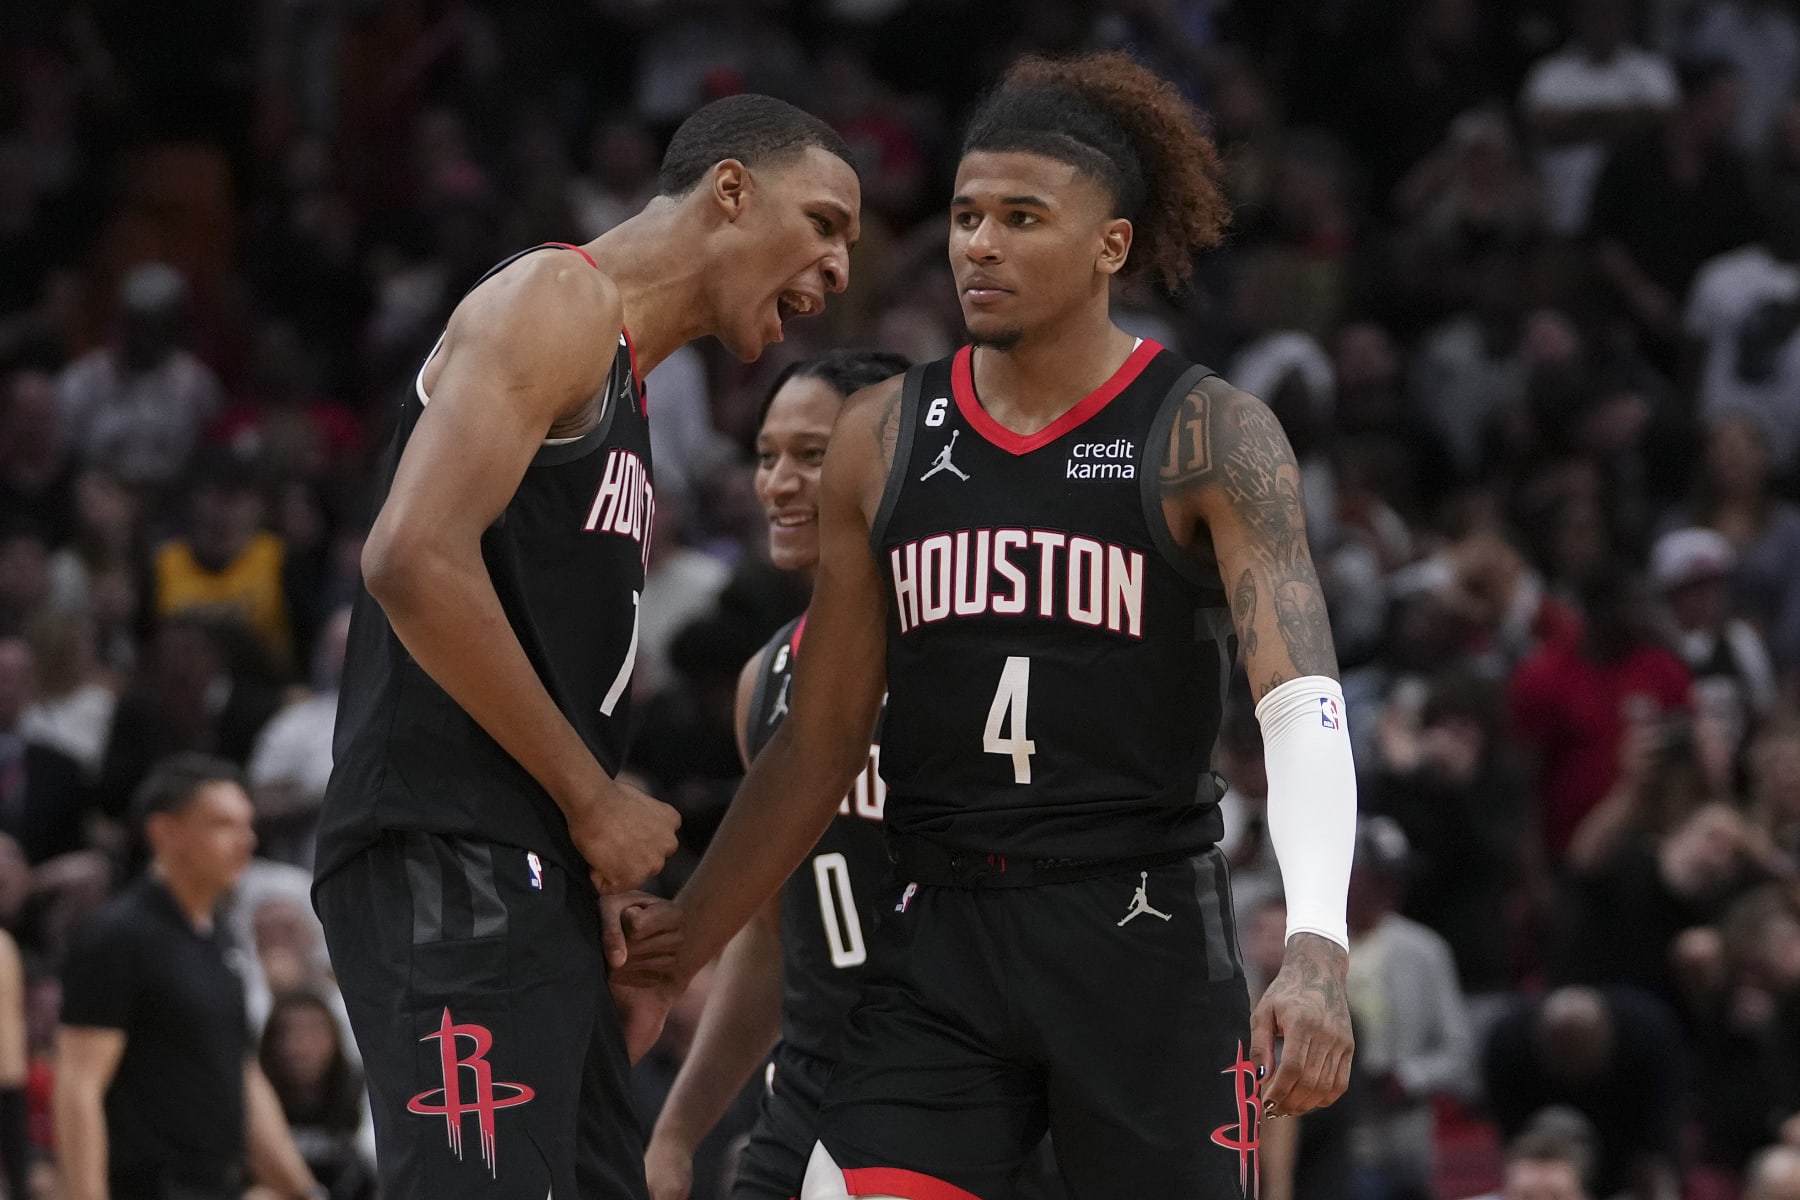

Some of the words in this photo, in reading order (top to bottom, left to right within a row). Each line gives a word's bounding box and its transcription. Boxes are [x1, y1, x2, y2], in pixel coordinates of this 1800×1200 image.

[924, 397, 949, 427] 6
[1073, 439, 1135, 458] credit
[1066, 459, 1135, 479] karma
[889, 527, 1145, 640] HOUSTON
[772, 644, 790, 674] 6
[982, 656, 1036, 785] 4
[813, 852, 867, 968] 0
